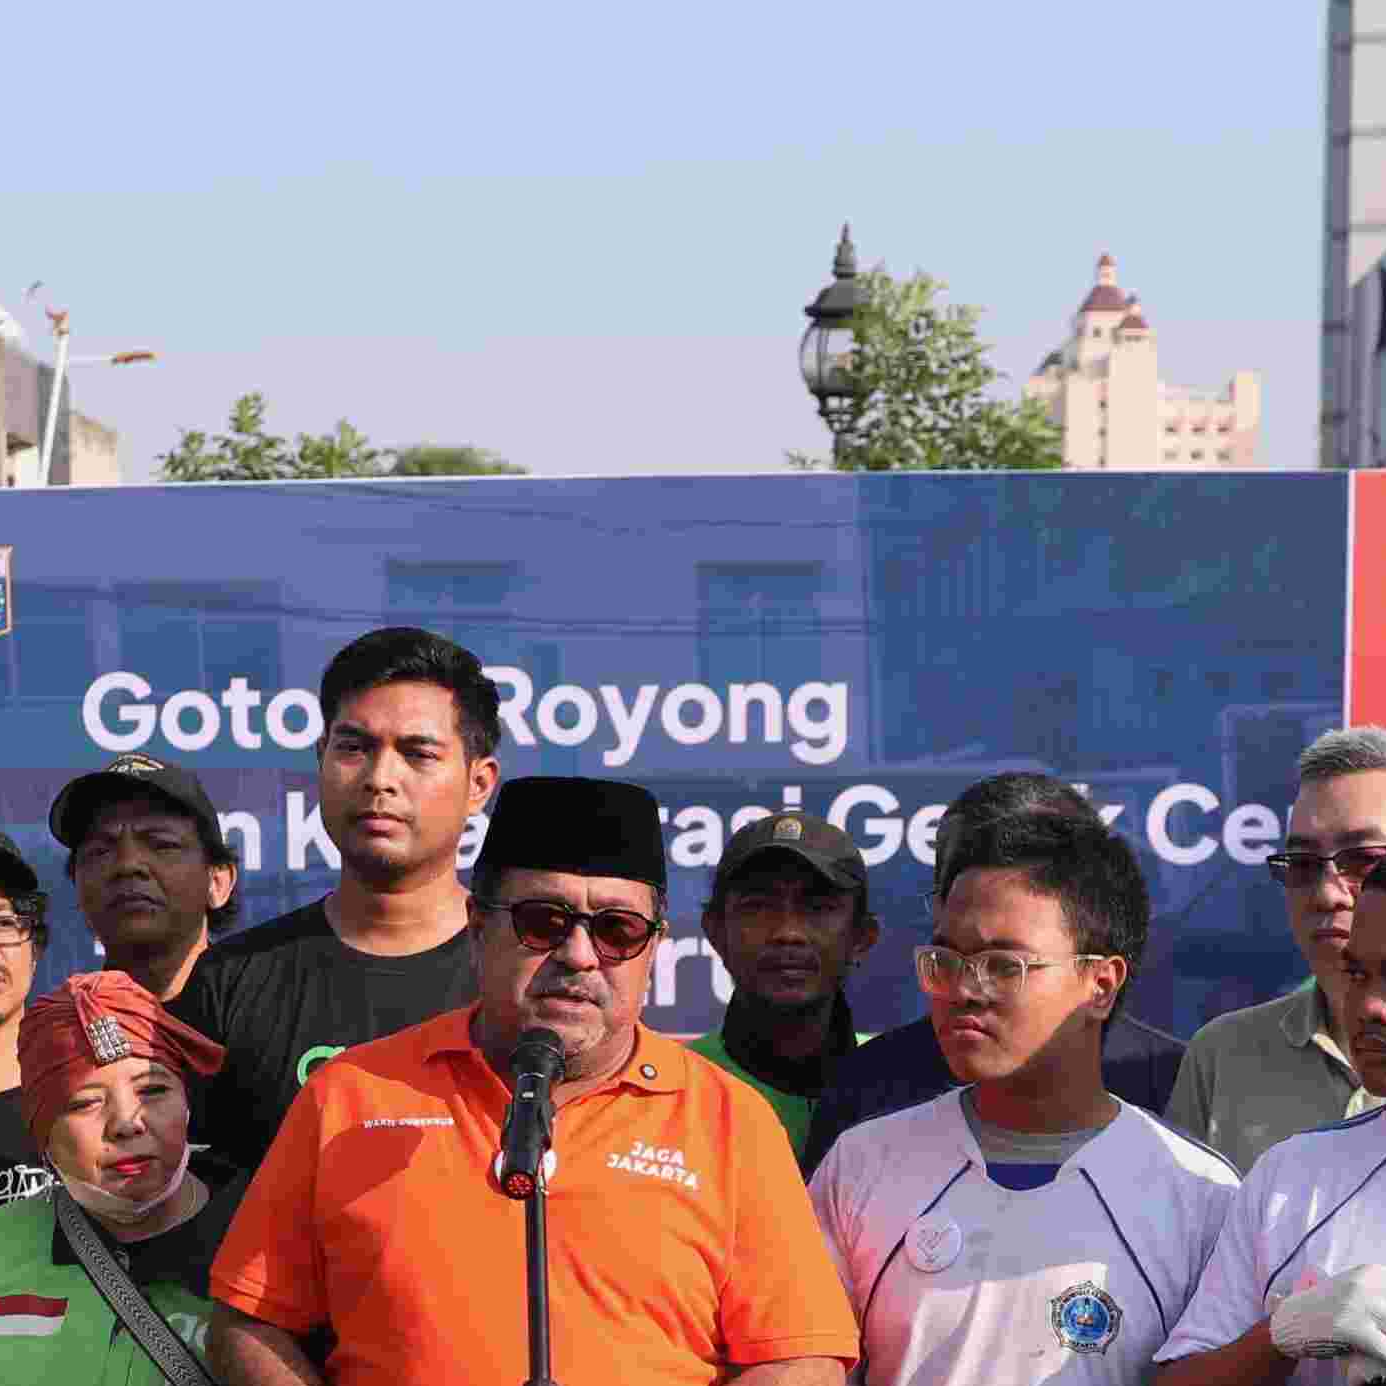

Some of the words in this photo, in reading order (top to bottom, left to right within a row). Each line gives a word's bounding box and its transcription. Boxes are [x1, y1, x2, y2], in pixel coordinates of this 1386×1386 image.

[82, 671, 325, 752] Goto
[481, 666, 848, 766] Royong
[606, 1153, 701, 1191] JAKARTA
[630, 1141, 684, 1167] JAGA
